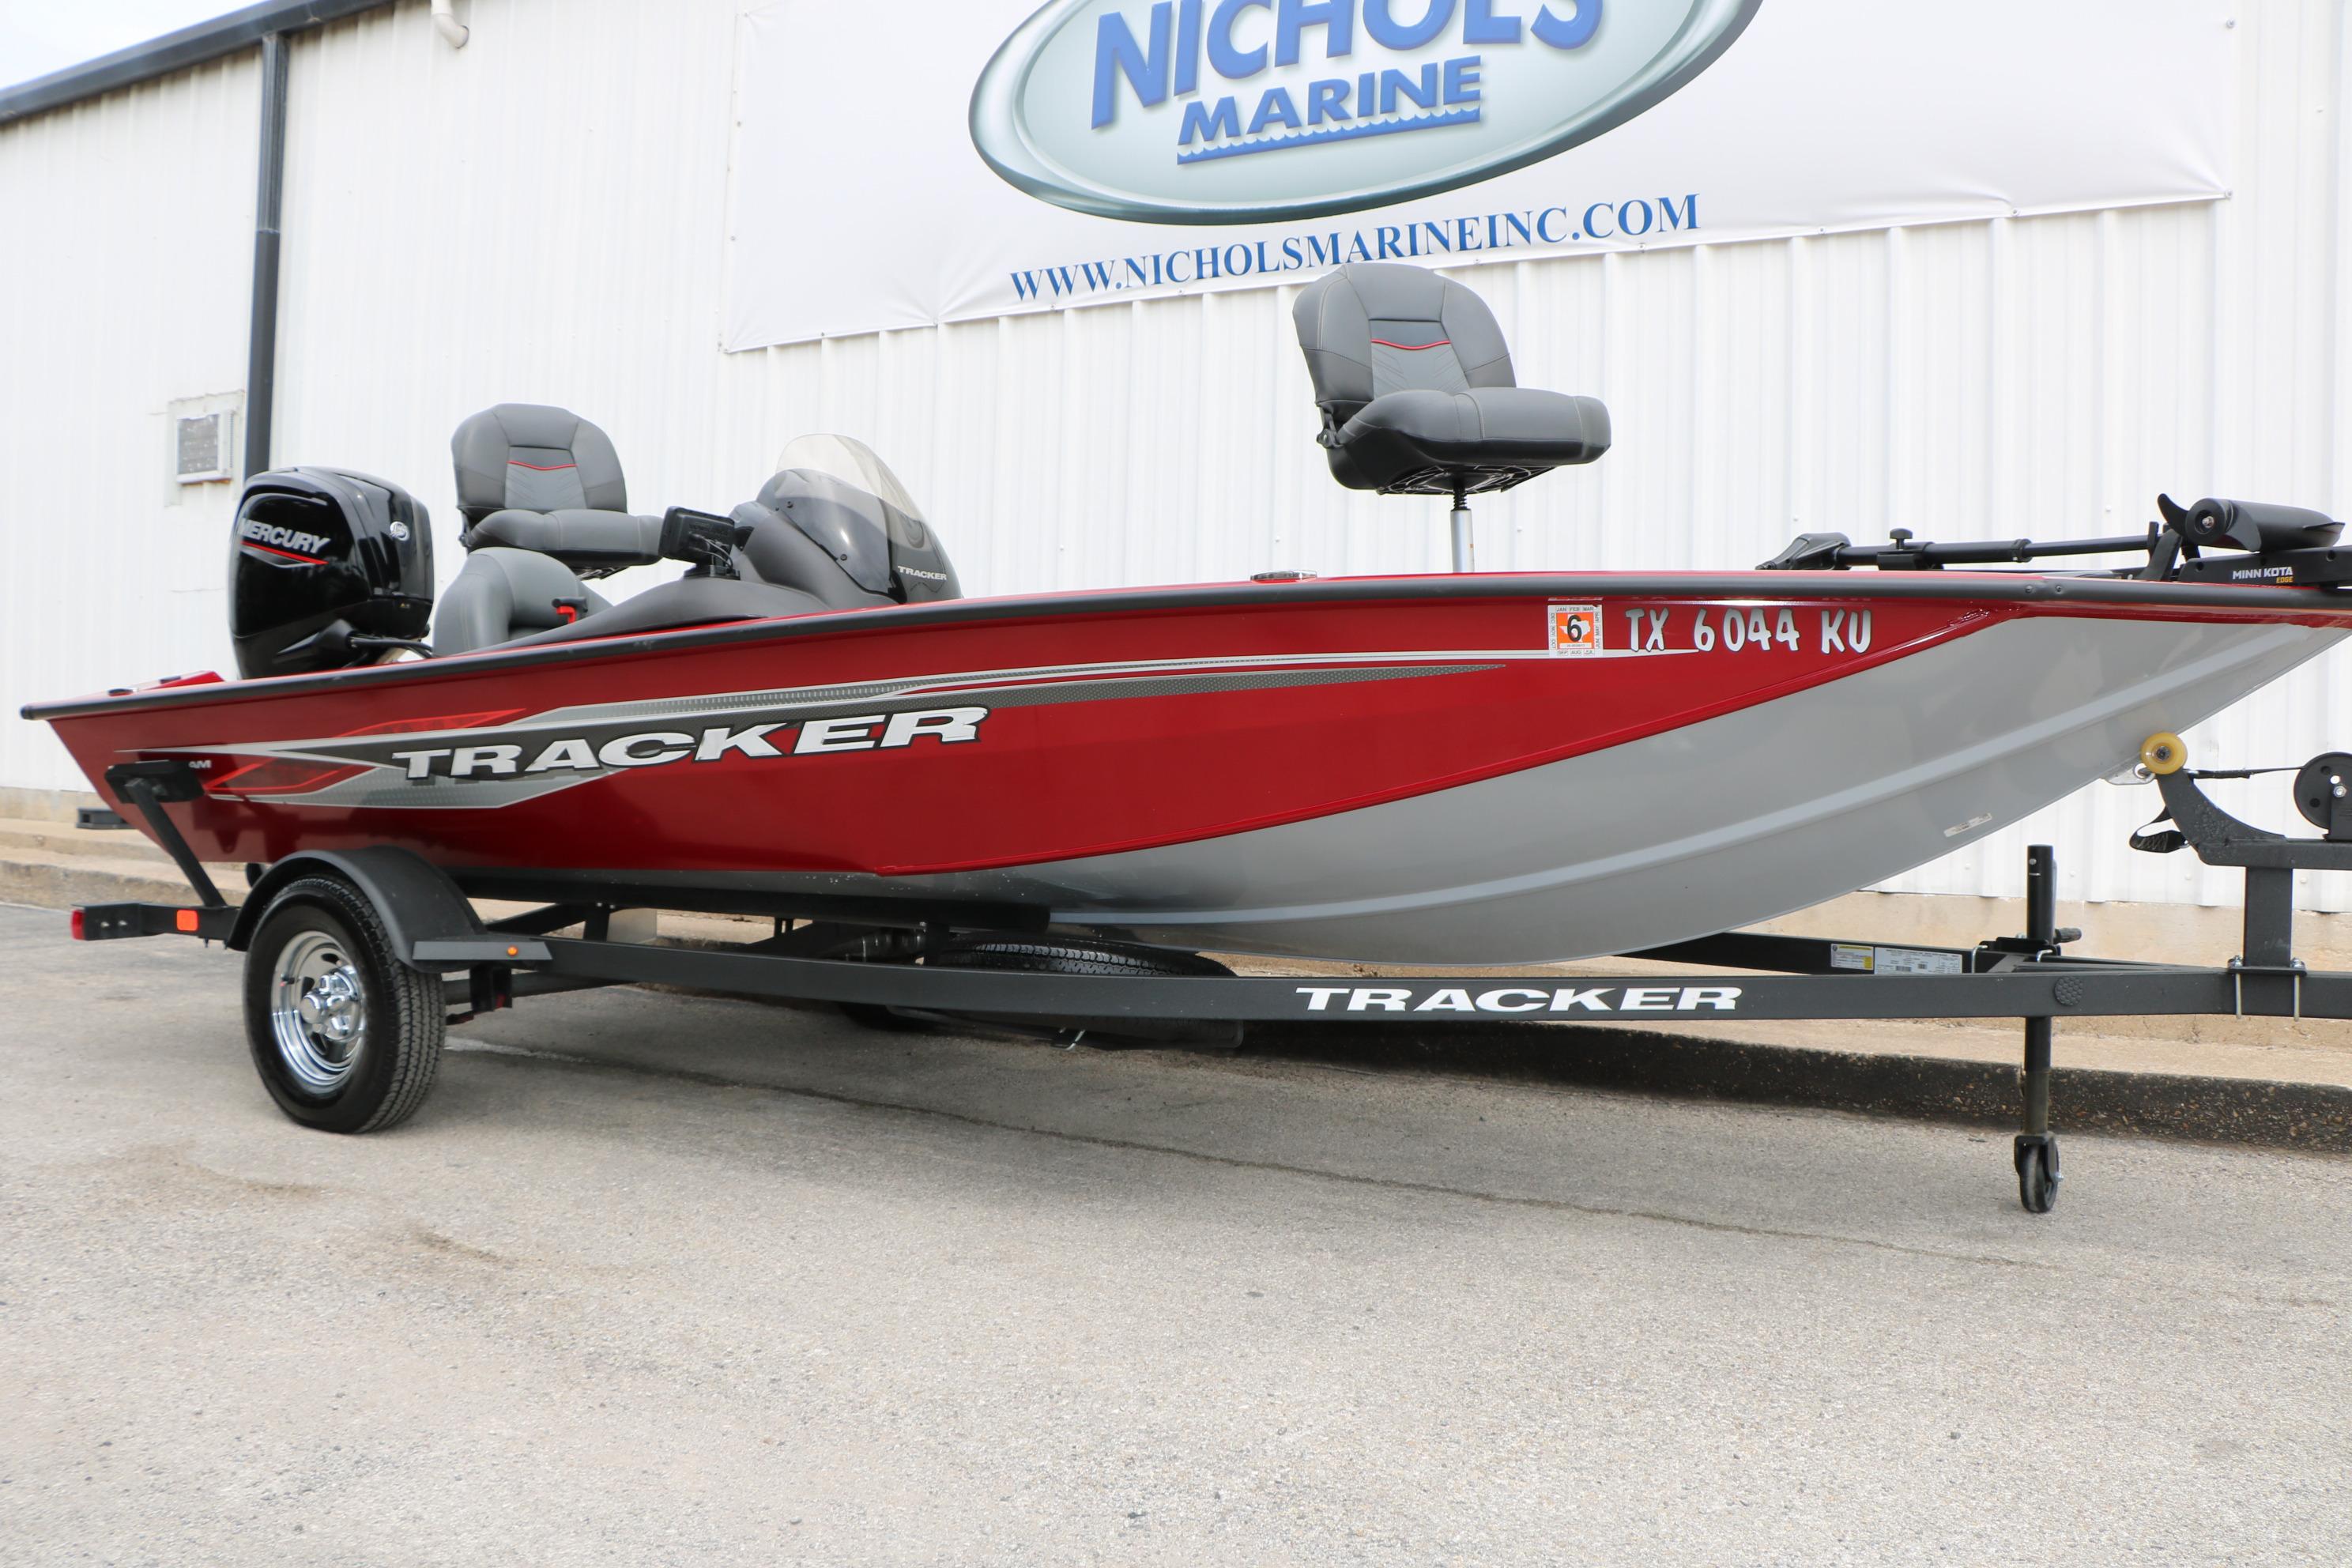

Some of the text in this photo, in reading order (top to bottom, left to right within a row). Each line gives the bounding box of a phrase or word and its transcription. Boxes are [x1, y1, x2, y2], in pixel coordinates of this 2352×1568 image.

[1178, 55, 1481, 145] MARINE
[1010, 193, 1701, 301] WWW.NICHOLSMARINEINC.COM
[237, 518, 331, 553] MERCURY
[897, 565, 948, 581] TRACKER
[2233, 566, 2294, 580] MINN KOTA
[1567, 614, 1582, 643] 6
[1625, 607, 1872, 655] TX 6044 KU
[391, 706, 990, 781] TRACKER
[1296, 986, 1743, 1012] TRACKER
